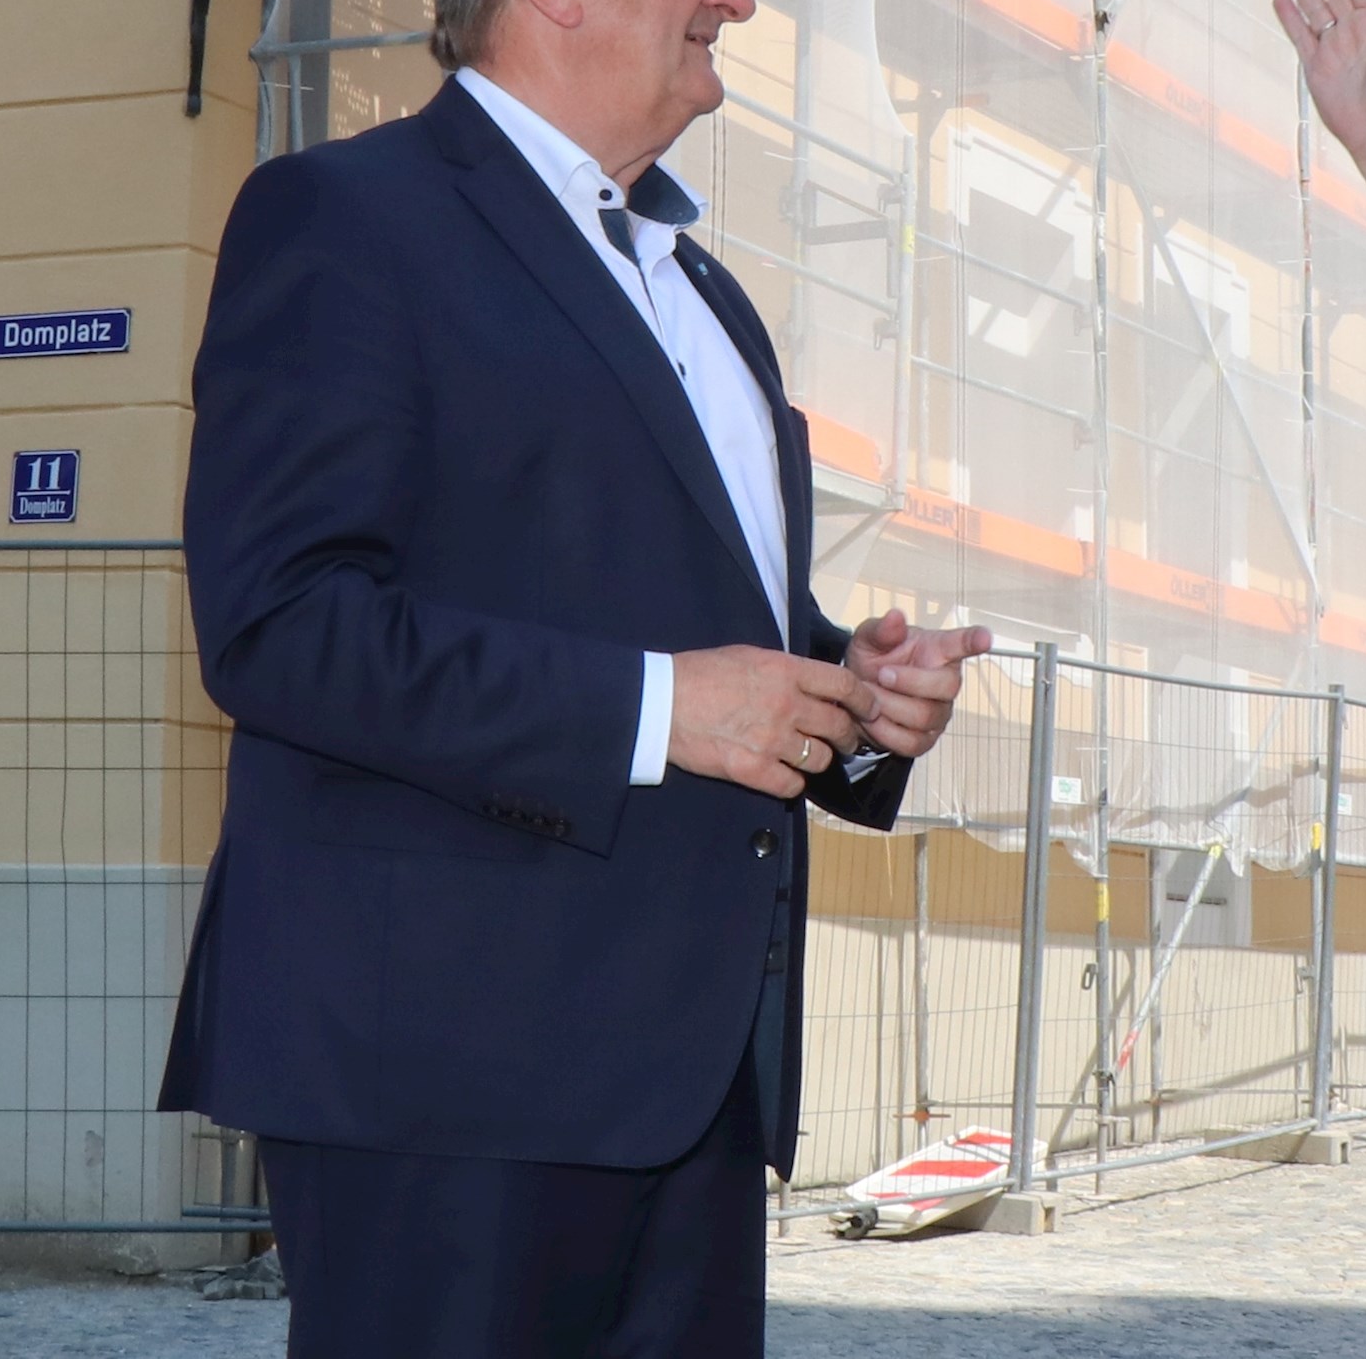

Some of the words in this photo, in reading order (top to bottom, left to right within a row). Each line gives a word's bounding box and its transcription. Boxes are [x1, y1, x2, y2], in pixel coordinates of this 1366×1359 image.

[4, 318, 111, 350] Domplatz
[27, 457, 61, 490] 11
[19, 496, 65, 518] Domplatz
